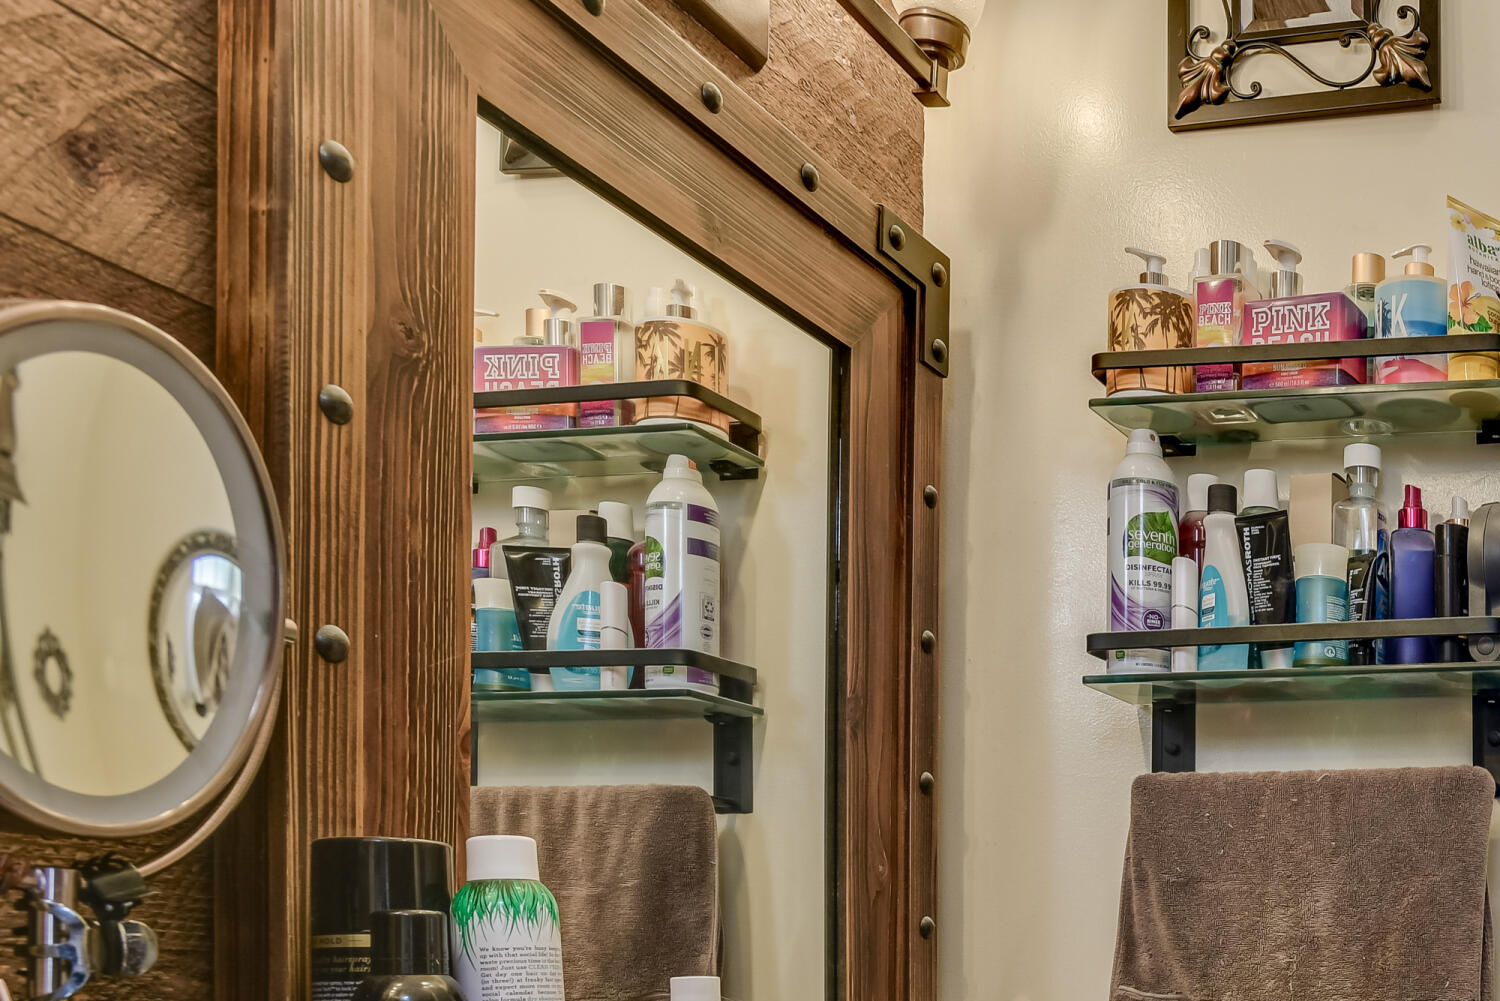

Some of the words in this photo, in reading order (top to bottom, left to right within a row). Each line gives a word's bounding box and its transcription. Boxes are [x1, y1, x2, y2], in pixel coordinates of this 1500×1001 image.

[1467, 234, 1497, 256] alba
[1199, 302, 1232, 314] PINK
[1198, 313, 1232, 325] BEACH
[1252, 302, 1331, 336] PINK
[1128, 530, 1175, 546] seventh
[1128, 540, 1175, 554] generation
[1129, 579, 1151, 587] KILLS
